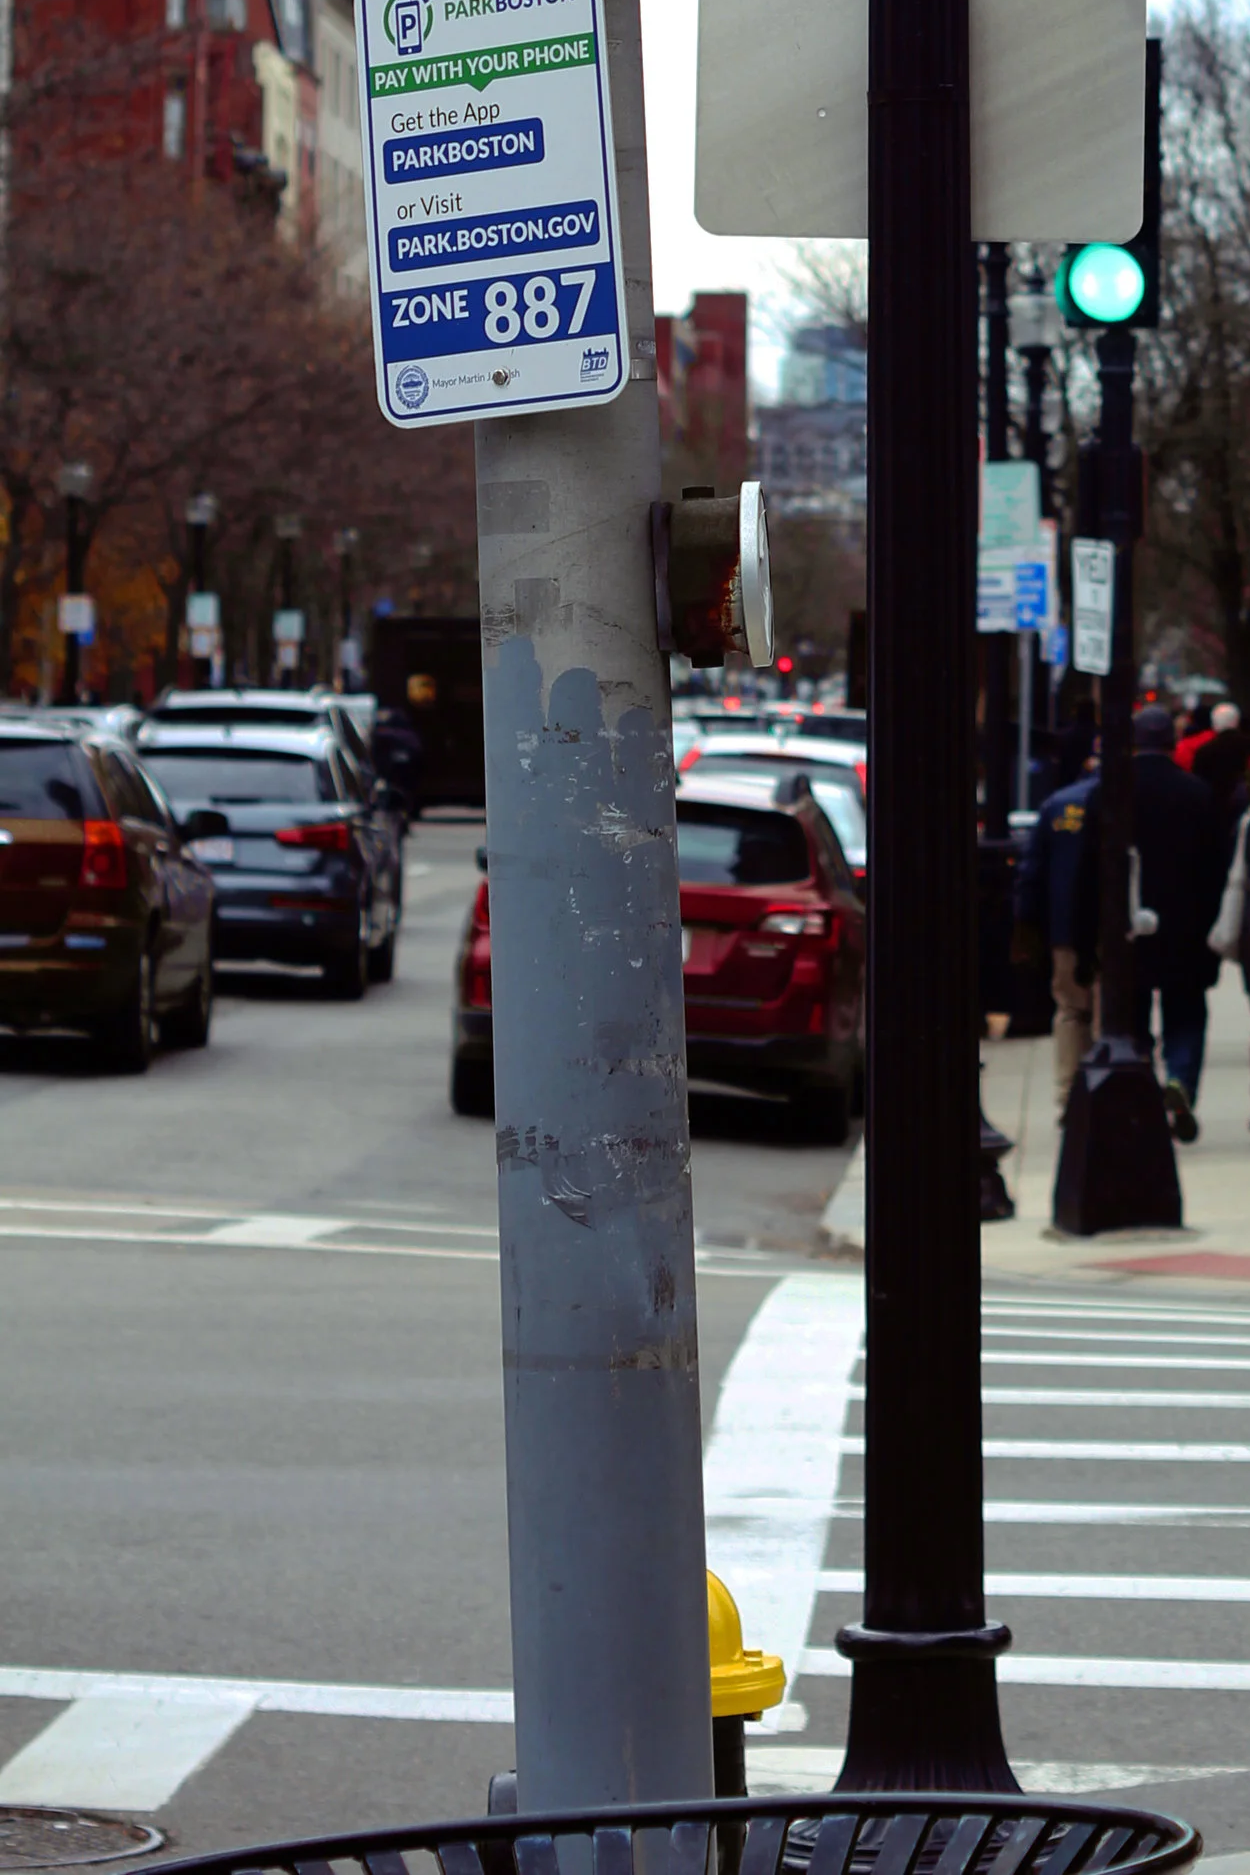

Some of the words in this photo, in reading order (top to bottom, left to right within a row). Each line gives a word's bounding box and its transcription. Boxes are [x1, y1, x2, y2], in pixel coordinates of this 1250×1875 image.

[374, 65, 408, 90] PAY
[410, 56, 463, 85] WITH
[466, 48, 520, 77] YOUR
[523, 39, 590, 69] PHONE
[390, 110, 425, 134] Get
[428, 106, 460, 129] the
[463, 101, 502, 129] App
[392, 130, 535, 172] PARKBOSTON
[396, 203, 417, 221] or
[420, 192, 463, 217] Visit
[397, 211, 596, 260] PARK.BOSTON.GOV
[391, 289, 470, 328] ZONE
[484, 269, 598, 344] 887
[432, 377, 458, 389] Mayor
[459, 372, 486, 385] Martin
[582, 356, 607, 371] BTD
